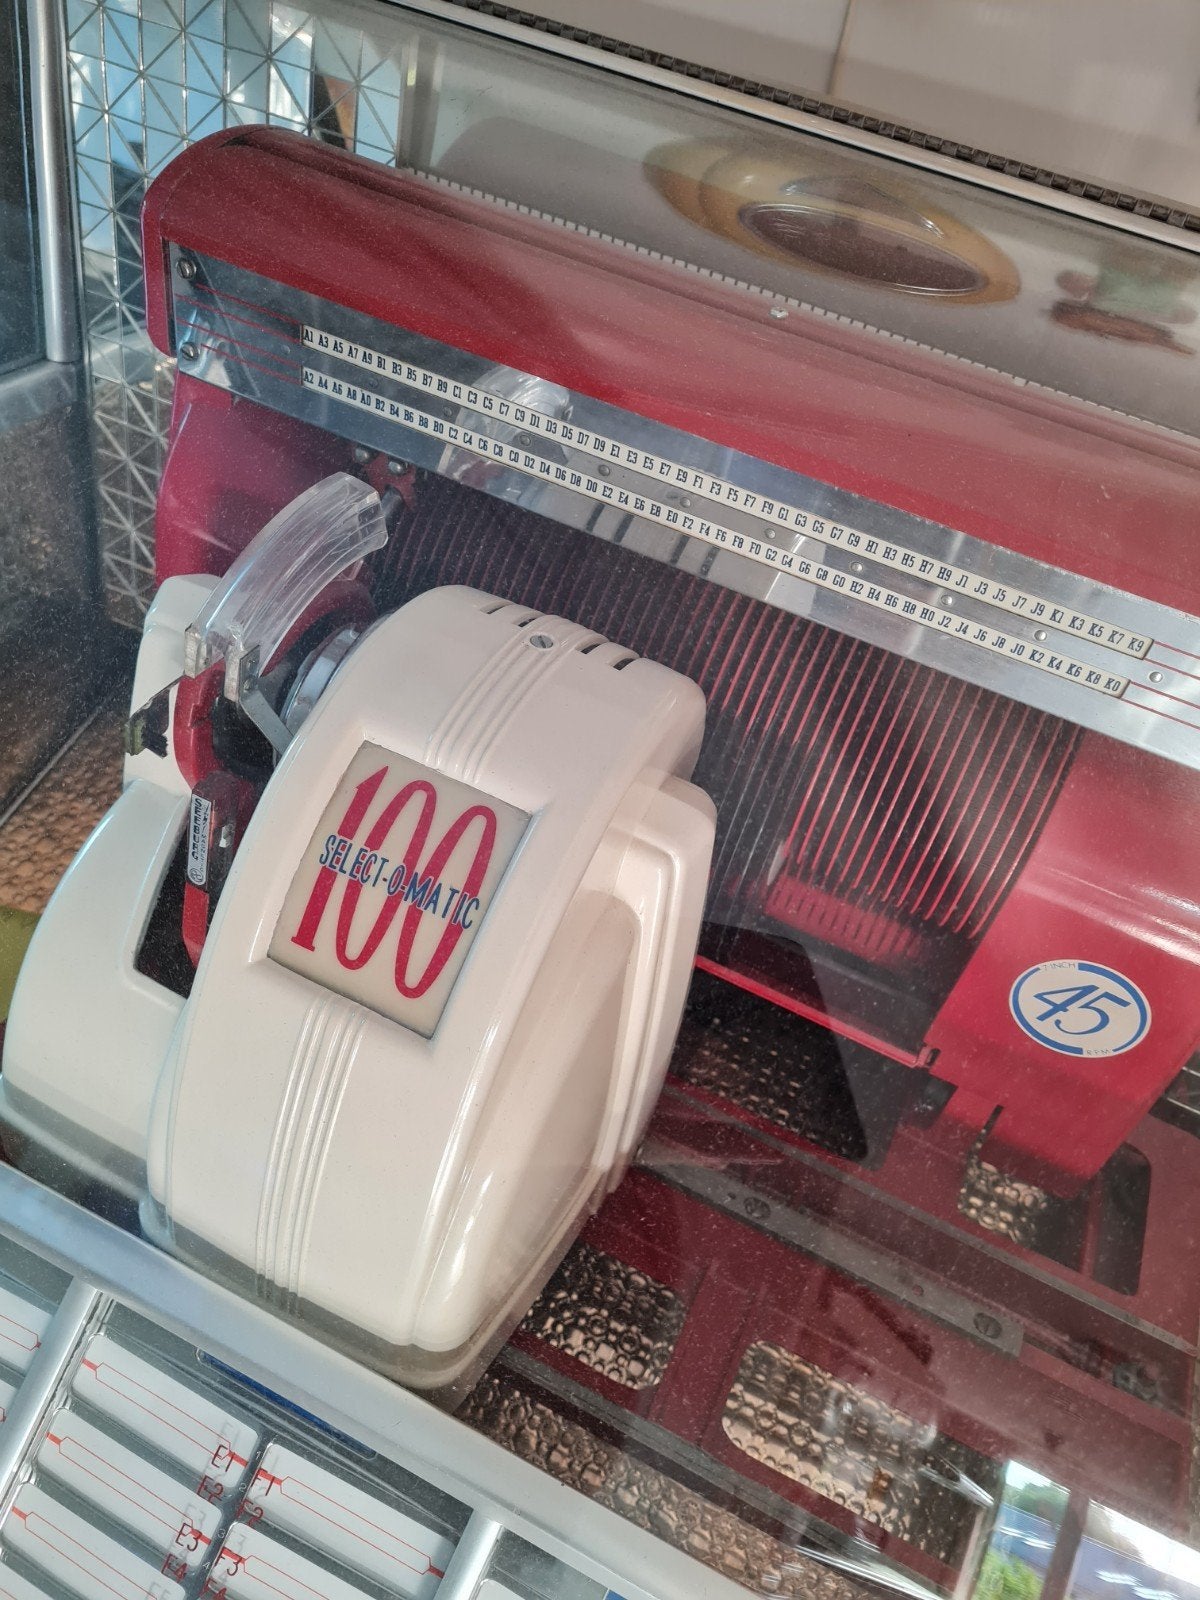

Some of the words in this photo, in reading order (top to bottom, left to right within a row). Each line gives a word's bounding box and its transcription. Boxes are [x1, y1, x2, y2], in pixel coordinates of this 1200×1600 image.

[304, 330, 314, 344] A1
[318, 334, 329, 349] A3
[333, 340, 343, 354] A5
[347, 346, 359, 360] A7
[362, 351, 373, 365] A9
[377, 356, 386, 370] B1
[392, 362, 402, 376] B3
[406, 368, 417, 382] B5
[422, 374, 433, 388] B7
[437, 379, 448, 394] B9
[453, 386, 462, 400] C1
[467, 391, 478, 405] C3
[483, 397, 493, 411] C5
[499, 403, 510, 417] C7
[515, 409, 525, 423] C9
[529, 414, 540, 429] D1
[545, 420, 558, 435] D3
[561, 426, 573, 441] D5
[577, 432, 590, 446] D7
[593, 438, 606, 453] D9
[610, 444, 621, 458] E1
[626, 450, 638, 464] E3
[642, 456, 655, 471] E5
[659, 462, 672, 477] E7
[675, 469, 688, 484] E9
[693, 475, 704, 489] F1
[709, 482, 722, 496] F3
[726, 488, 739, 502] F5
[743, 494, 757, 508] F7
[761, 501, 774, 515] F9
[778, 507, 789, 521] G1
[795, 514, 808, 528] G3
[812, 520, 826, 534] G5
[830, 527, 844, 541] G7
[847, 533, 861, 548] G9
[864, 540, 879, 555] H1
[882, 547, 898, 561] H3
[901, 553, 916, 568] H5
[918, 560, 935, 575] H7
[936, 567, 953, 582] H9
[955, 575, 969, 588] J1
[974, 582, 989, 595] J3
[992, 589, 1007, 602] J5
[1012, 596, 1028, 609] J7
[1030, 603, 1046, 616] J9
[1049, 609, 1064, 624] K1
[1068, 616, 1085, 631] K3
[1087, 623, 1105, 638] K5
[1107, 630, 1125, 645] K7
[1127, 638, 1144, 652] K9
[304, 371, 314, 384] A2
[318, 376, 328, 390] A4
[332, 382, 343, 396] A6
[346, 388, 357, 401] A8
[360, 392, 371, 407] A0
[375, 398, 385, 412] B2
[389, 404, 400, 418] B4
[403, 410, 414, 423] B6
[418, 415, 429, 429] B8
[433, 421, 444, 434] B0
[449, 427, 459, 440] C2
[463, 433, 473, 446] C4
[478, 438, 489, 452] C6
[493, 444, 503, 457] C8
[509, 450, 519, 463] C0
[524, 456, 535, 470] D2
[539, 462, 551, 476] D4
[554, 468, 567, 481] D6
[570, 473, 582, 487] D8
[586, 479, 598, 493] D0
[602, 486, 613, 499] E2
[618, 492, 629, 506] E4
[633, 498, 646, 512] E6
[649, 504, 662, 518] E8
[666, 510, 679, 524] E0
[682, 516, 694, 530] F2
[699, 523, 711, 537] F4
[715, 529, 727, 542] F6
[732, 536, 744, 549] F8
[749, 542, 761, 556] F0
[765, 548, 778, 562] G2
[781, 555, 794, 568] G4
[799, 562, 811, 575] G6
[816, 568, 829, 582] G8
[832, 575, 846, 588] G0
[849, 581, 864, 595] H2
[867, 587, 881, 602] H4
[884, 594, 899, 608] H6
[902, 601, 917, 615] H8
[919, 608, 936, 622] H0
[938, 616, 952, 629] J2
[955, 622, 969, 635] J4
[973, 629, 988, 642] J6
[992, 636, 1007, 649] J8
[1010, 644, 1025, 656] J0
[1028, 650, 1045, 664] K2
[1047, 656, 1063, 671] K4
[1065, 664, 1083, 678] K6
[1085, 671, 1102, 685] K8
[1103, 678, 1120, 692] K0
[291, 765, 497, 999] 100
[319, 834, 480, 930] SELECT-O-MATIC
[1033, 984, 1132, 1035] 45
[212, 1444, 235, 1472] E1
[197, 1475, 224, 1503] E2
[176, 1522, 202, 1551] E3
[161, 1553, 188, 1582] E4
